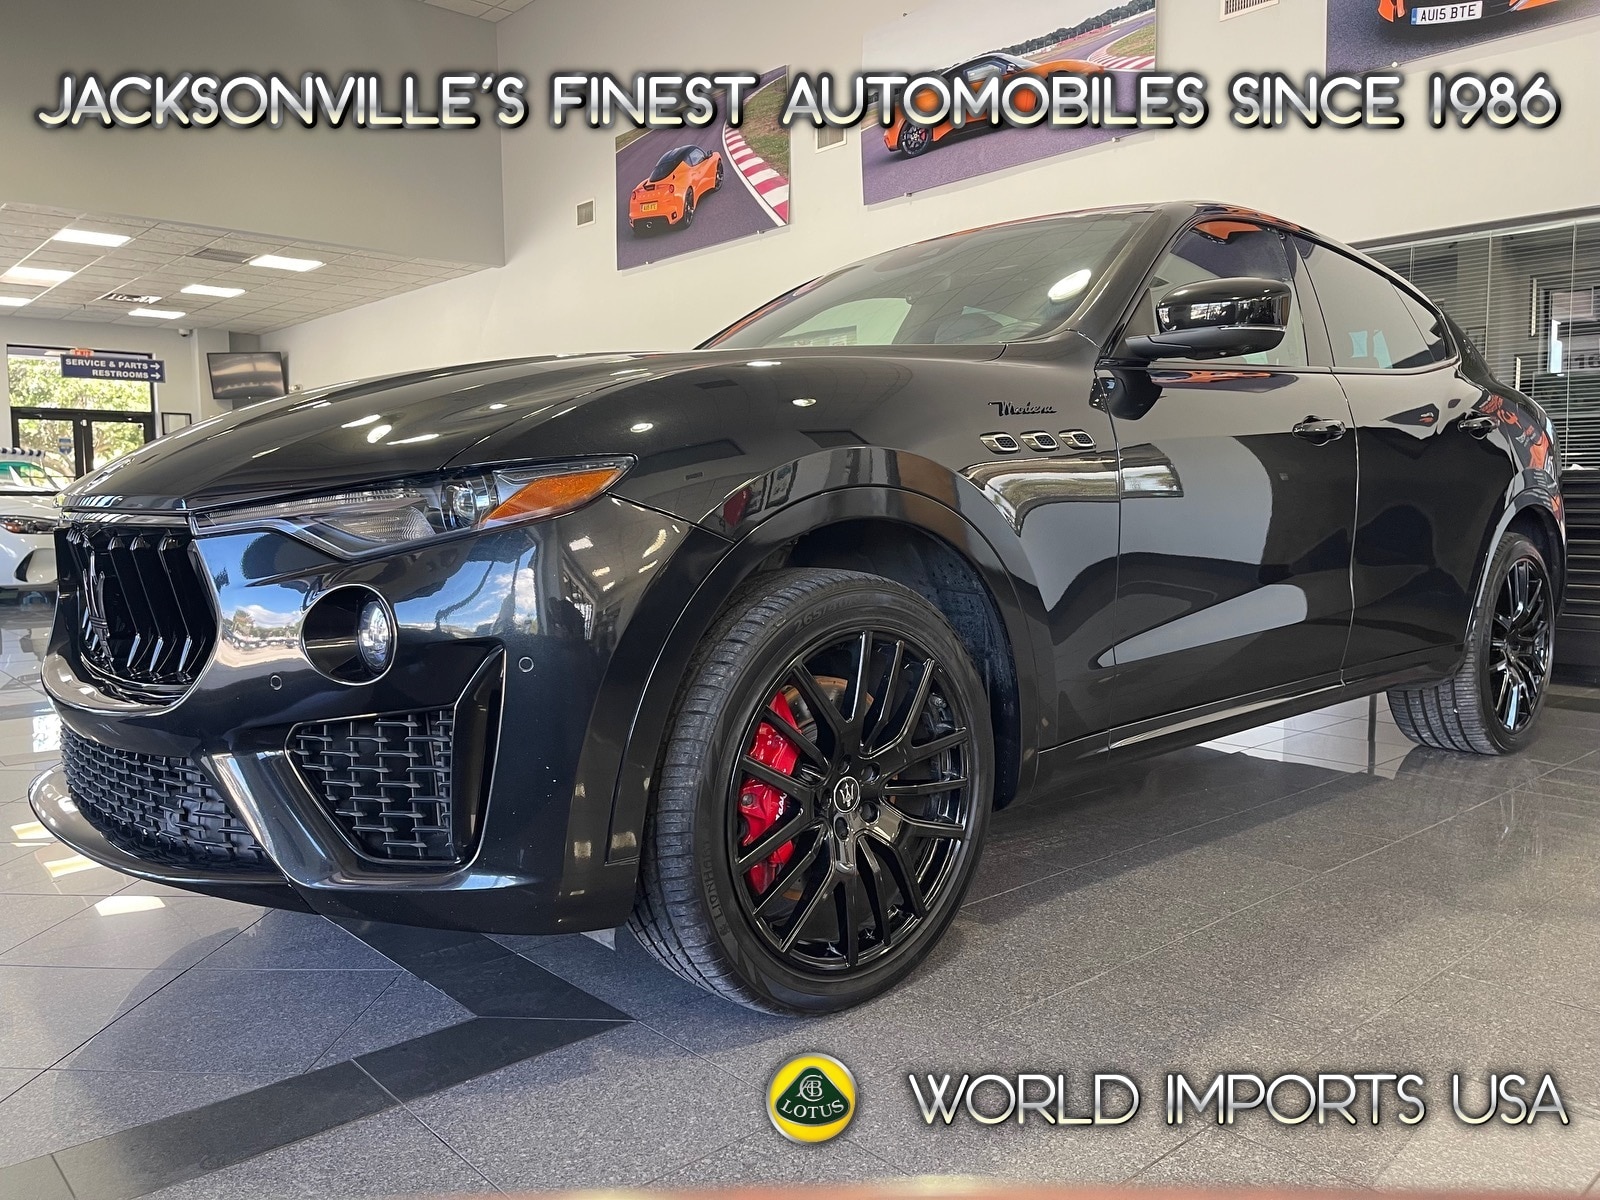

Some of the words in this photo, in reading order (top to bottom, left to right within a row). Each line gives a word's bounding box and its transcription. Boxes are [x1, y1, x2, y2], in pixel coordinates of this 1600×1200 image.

[1420, 8, 1446, 22] AU15
[1450, 4, 1477, 19] BTE
[65, 359, 106, 367] SERVICE
[118, 361, 148, 369] PARTS
[92, 369, 149, 379] RESTROOMS
